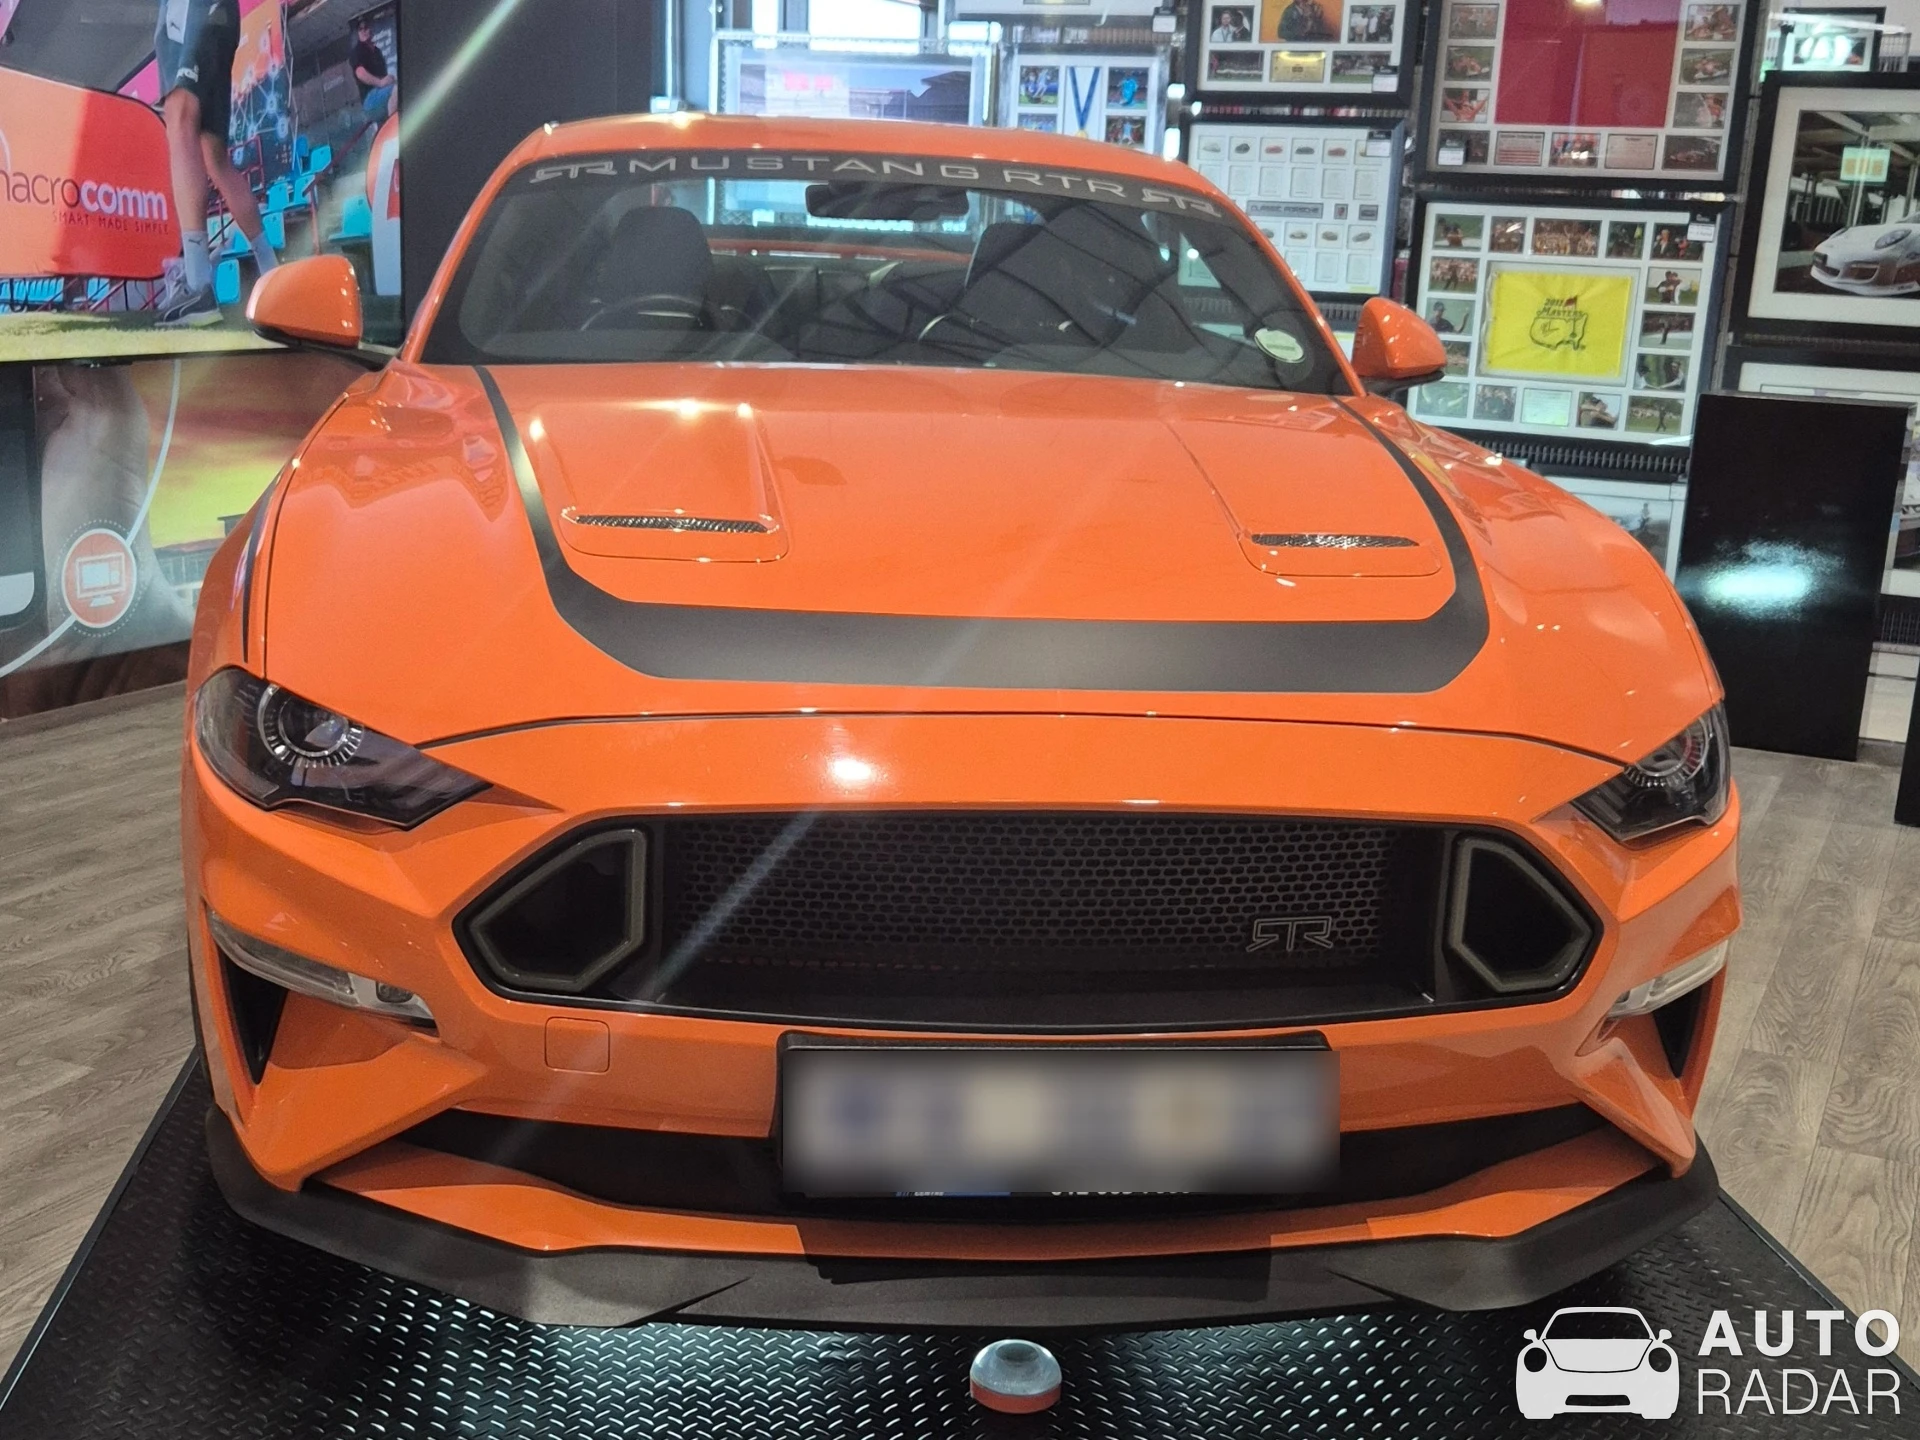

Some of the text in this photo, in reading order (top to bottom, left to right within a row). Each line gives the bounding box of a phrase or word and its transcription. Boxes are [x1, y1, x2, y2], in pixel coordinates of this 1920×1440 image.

[629, 155, 1127, 198] MUSTANG RTR
[52, 210, 170, 236] SMART MADE SIMPLE
